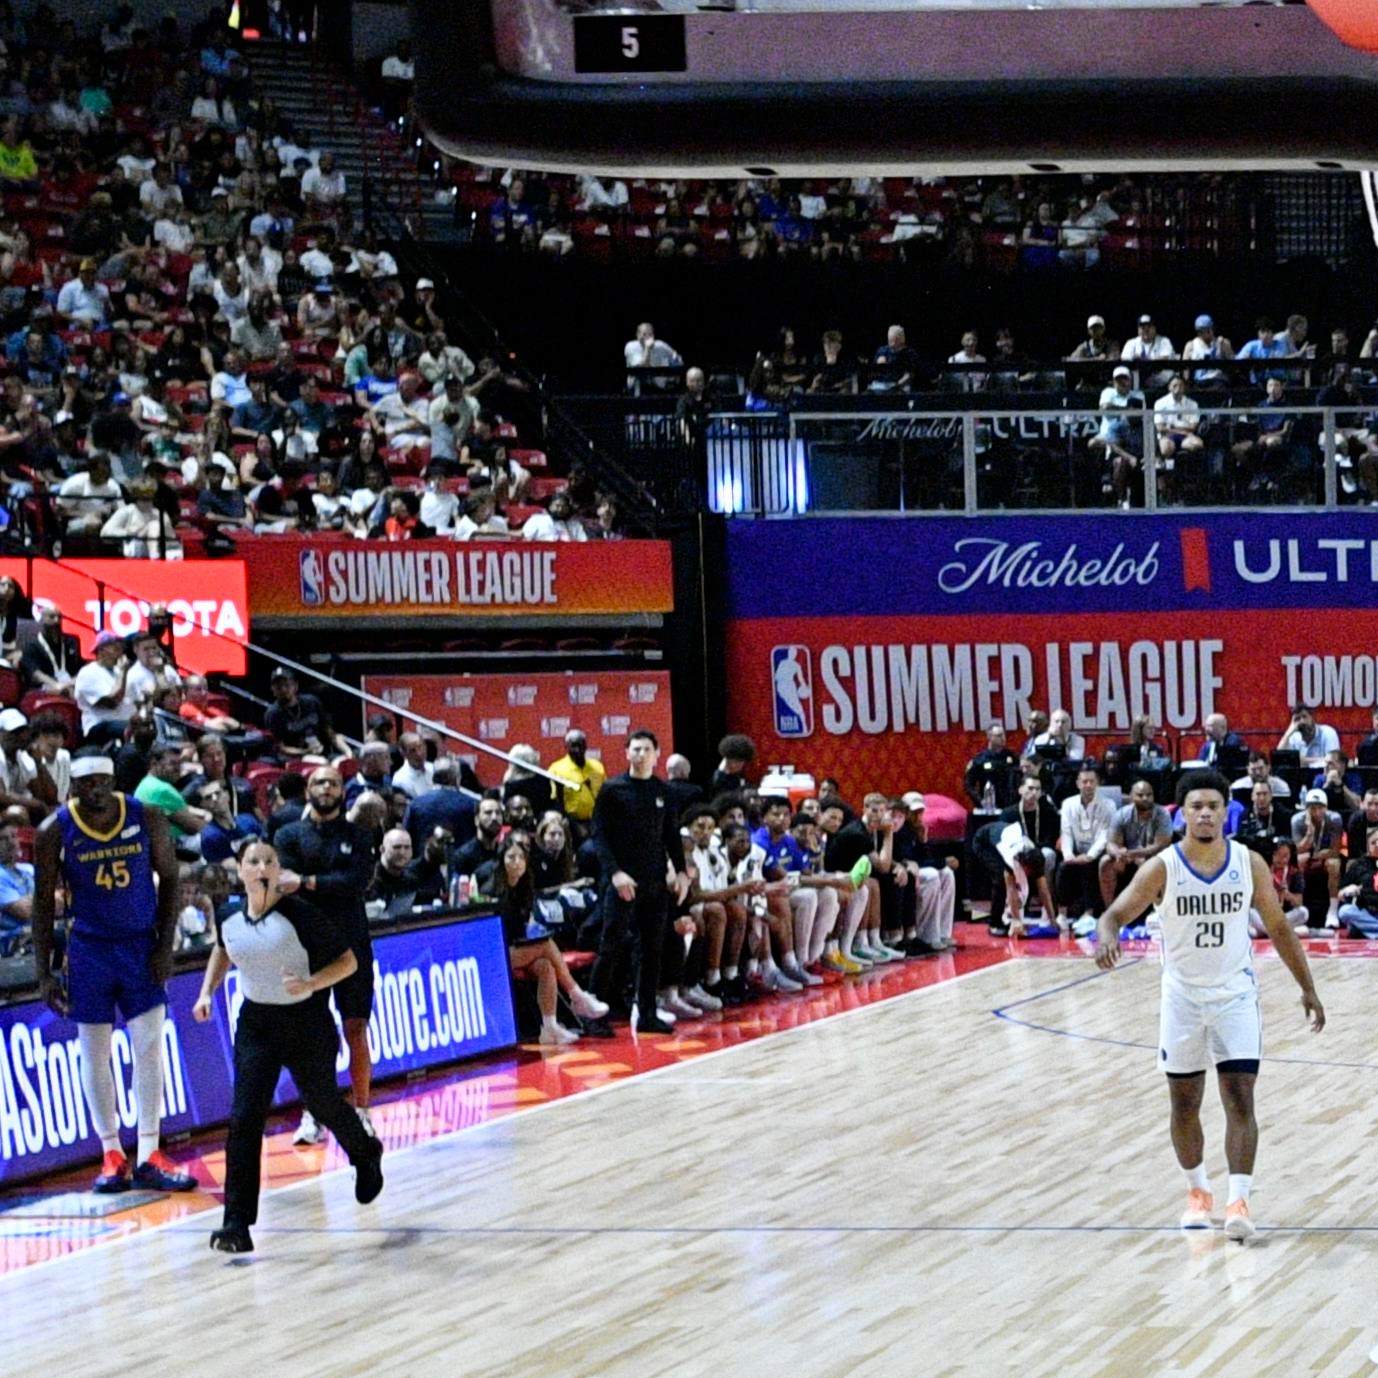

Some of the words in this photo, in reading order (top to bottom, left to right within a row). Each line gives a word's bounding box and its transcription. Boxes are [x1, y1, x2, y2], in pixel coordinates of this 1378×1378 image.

[621, 26, 640, 58] 5
[328, 550, 451, 605] SUMMER
[456, 550, 558, 605] LEAGUE
[937, 537, 1160, 593] Michelob
[820, 642, 1034, 735] SUMMER
[1045, 639, 1224, 732] LEAGUE
[95, 860, 131, 891] 45
[1176, 891, 1243, 917] DALLAS
[1195, 921, 1225, 949] 29
